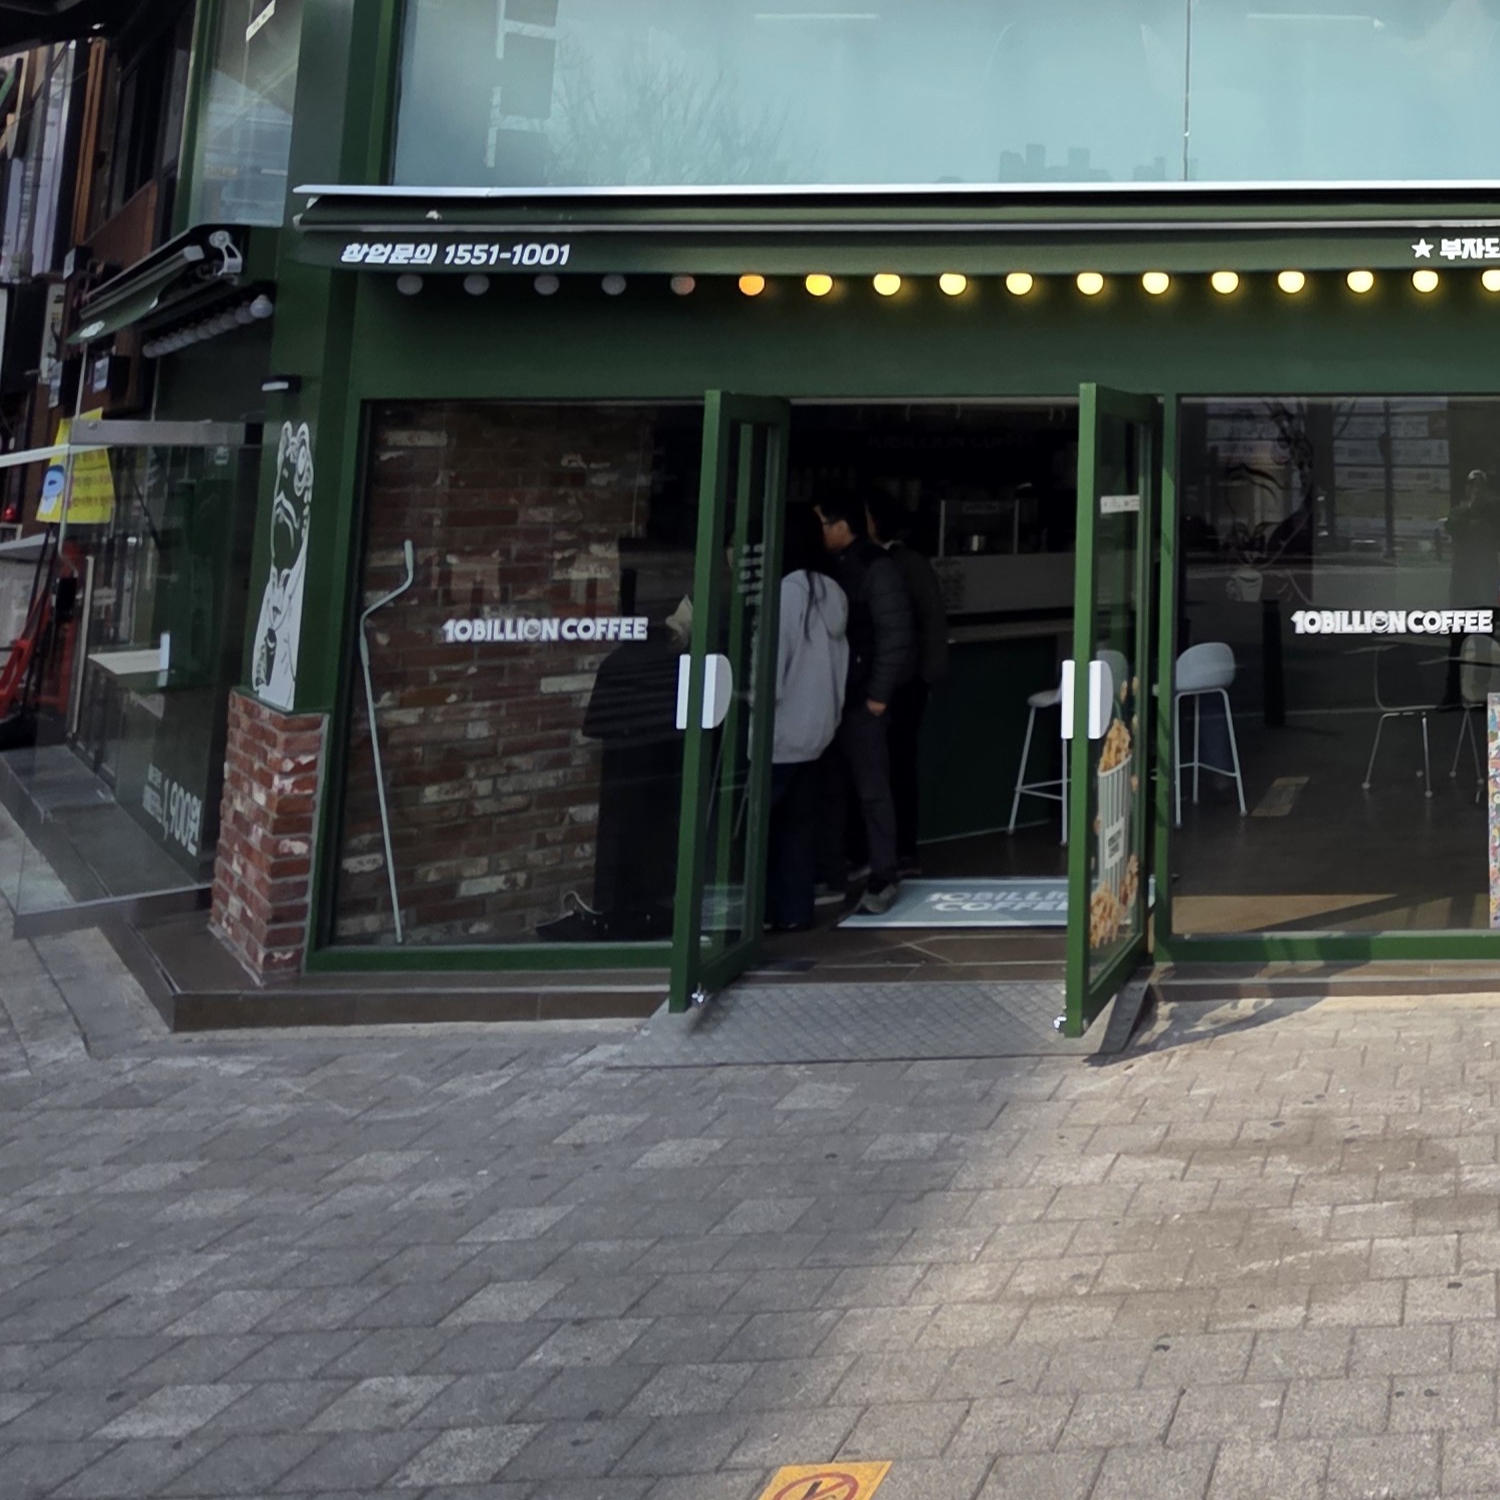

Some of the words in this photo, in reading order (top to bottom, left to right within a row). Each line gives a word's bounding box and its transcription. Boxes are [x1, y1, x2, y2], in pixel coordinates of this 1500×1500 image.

[341, 242, 438, 265] 창업문의
[444, 243, 571, 266] 1551-1001
[442, 617, 561, 642] 10BILLION
[561, 616, 649, 641] COFFEE
[1290, 610, 1407, 634] 10BILLION
[1407, 610, 1494, 634] COFFEE
